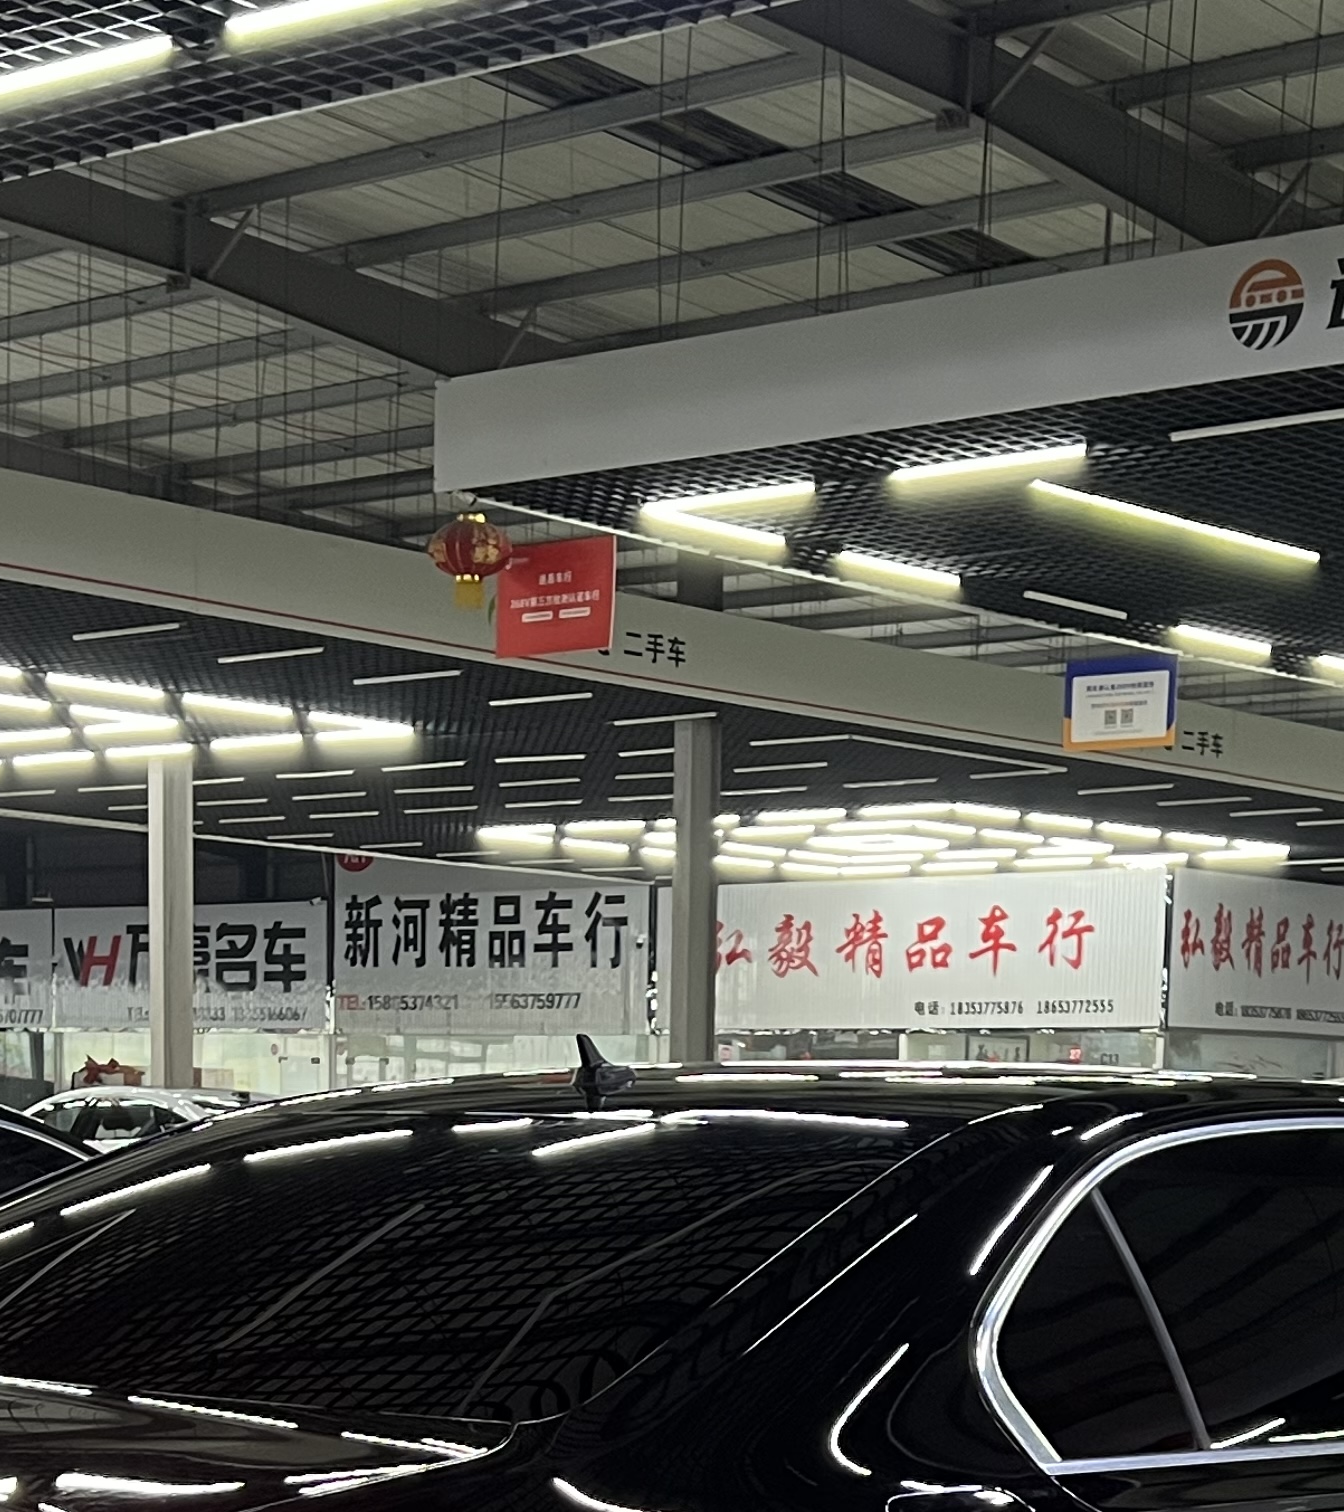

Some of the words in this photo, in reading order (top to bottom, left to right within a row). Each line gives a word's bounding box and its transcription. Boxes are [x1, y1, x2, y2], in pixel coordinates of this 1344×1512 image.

[623, 631, 686, 668] 二手车
[1181, 730, 1223, 759] 二手车
[344, 891, 628, 968] 新河精品车行
